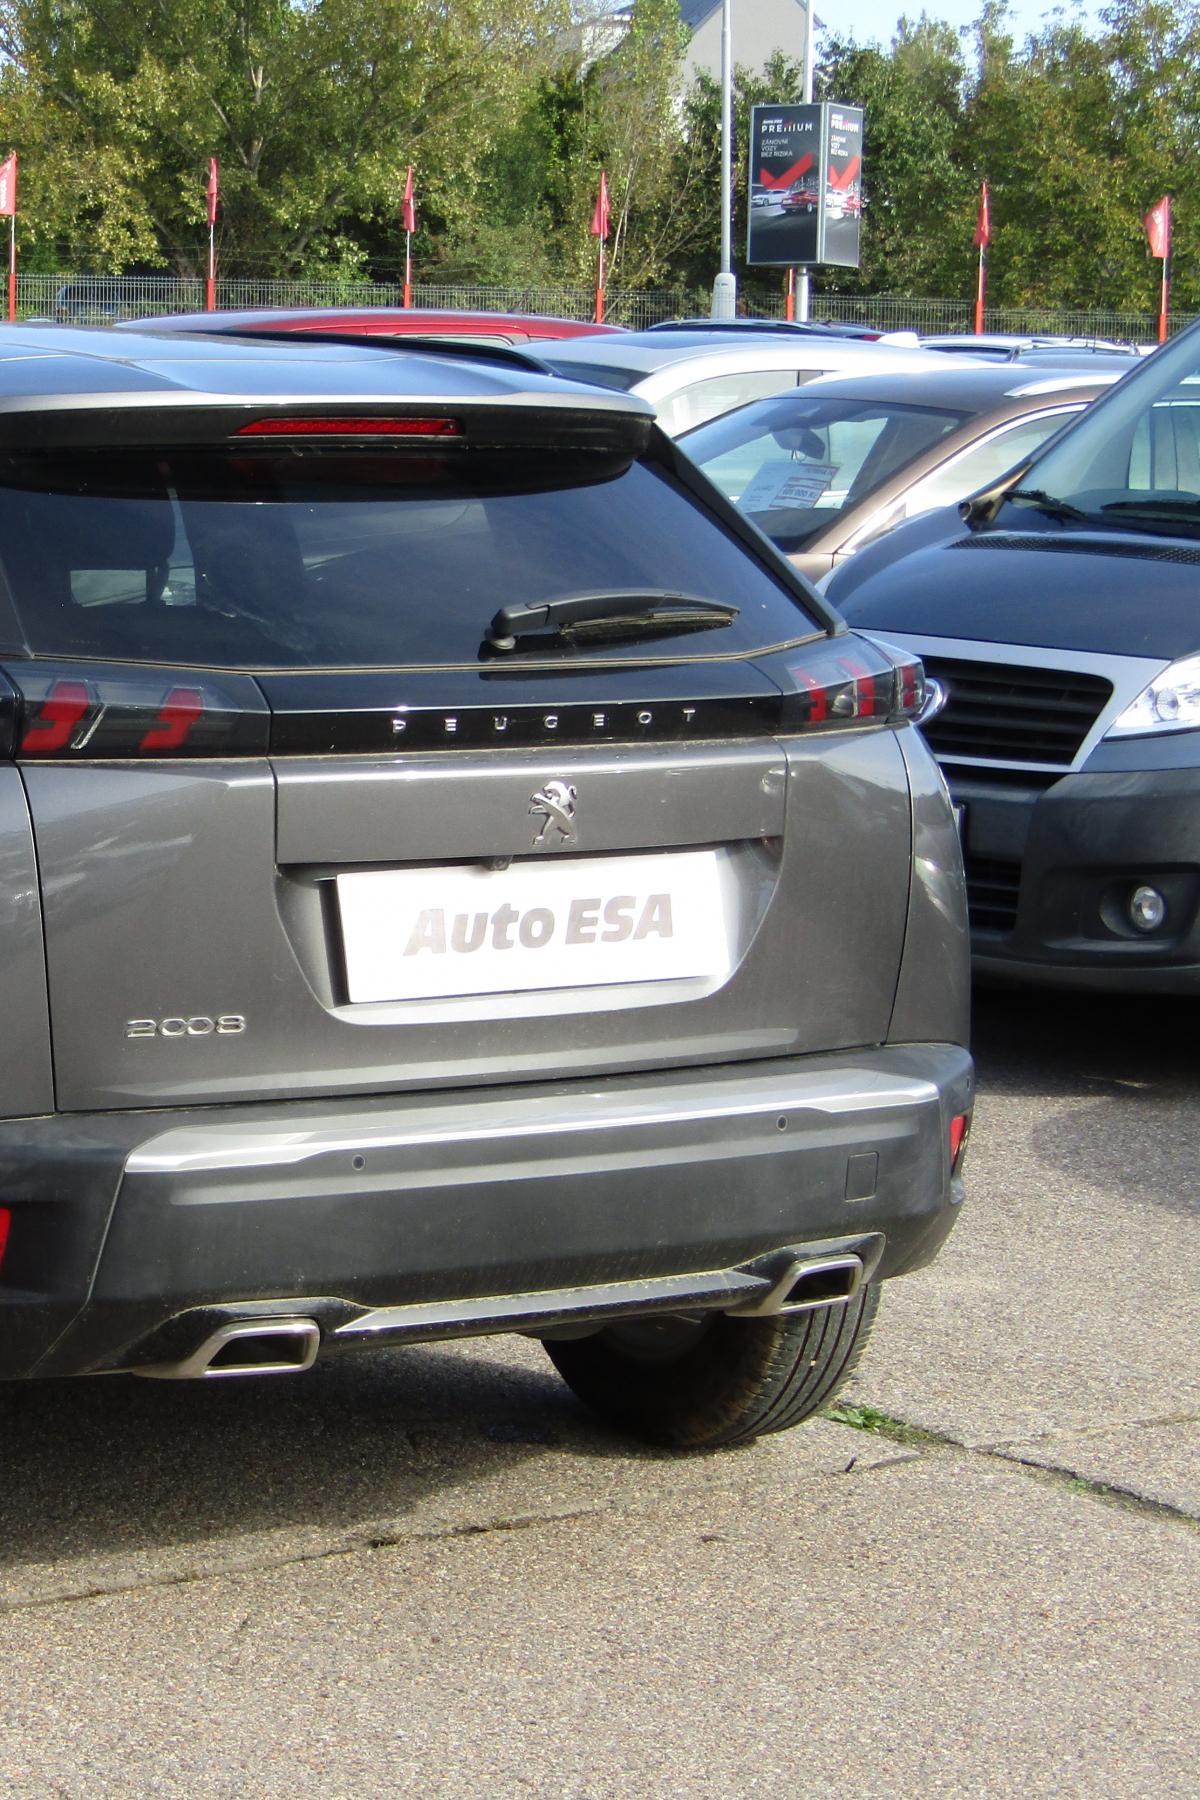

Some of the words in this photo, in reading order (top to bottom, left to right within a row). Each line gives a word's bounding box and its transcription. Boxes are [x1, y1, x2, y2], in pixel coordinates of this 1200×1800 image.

[761, 122, 813, 133] PREMIUM
[391, 707, 697, 735] PEUGEOT
[402, 902, 556, 957] Auto
[564, 893, 674, 945] ESA
[126, 1014, 247, 1039] 2008
